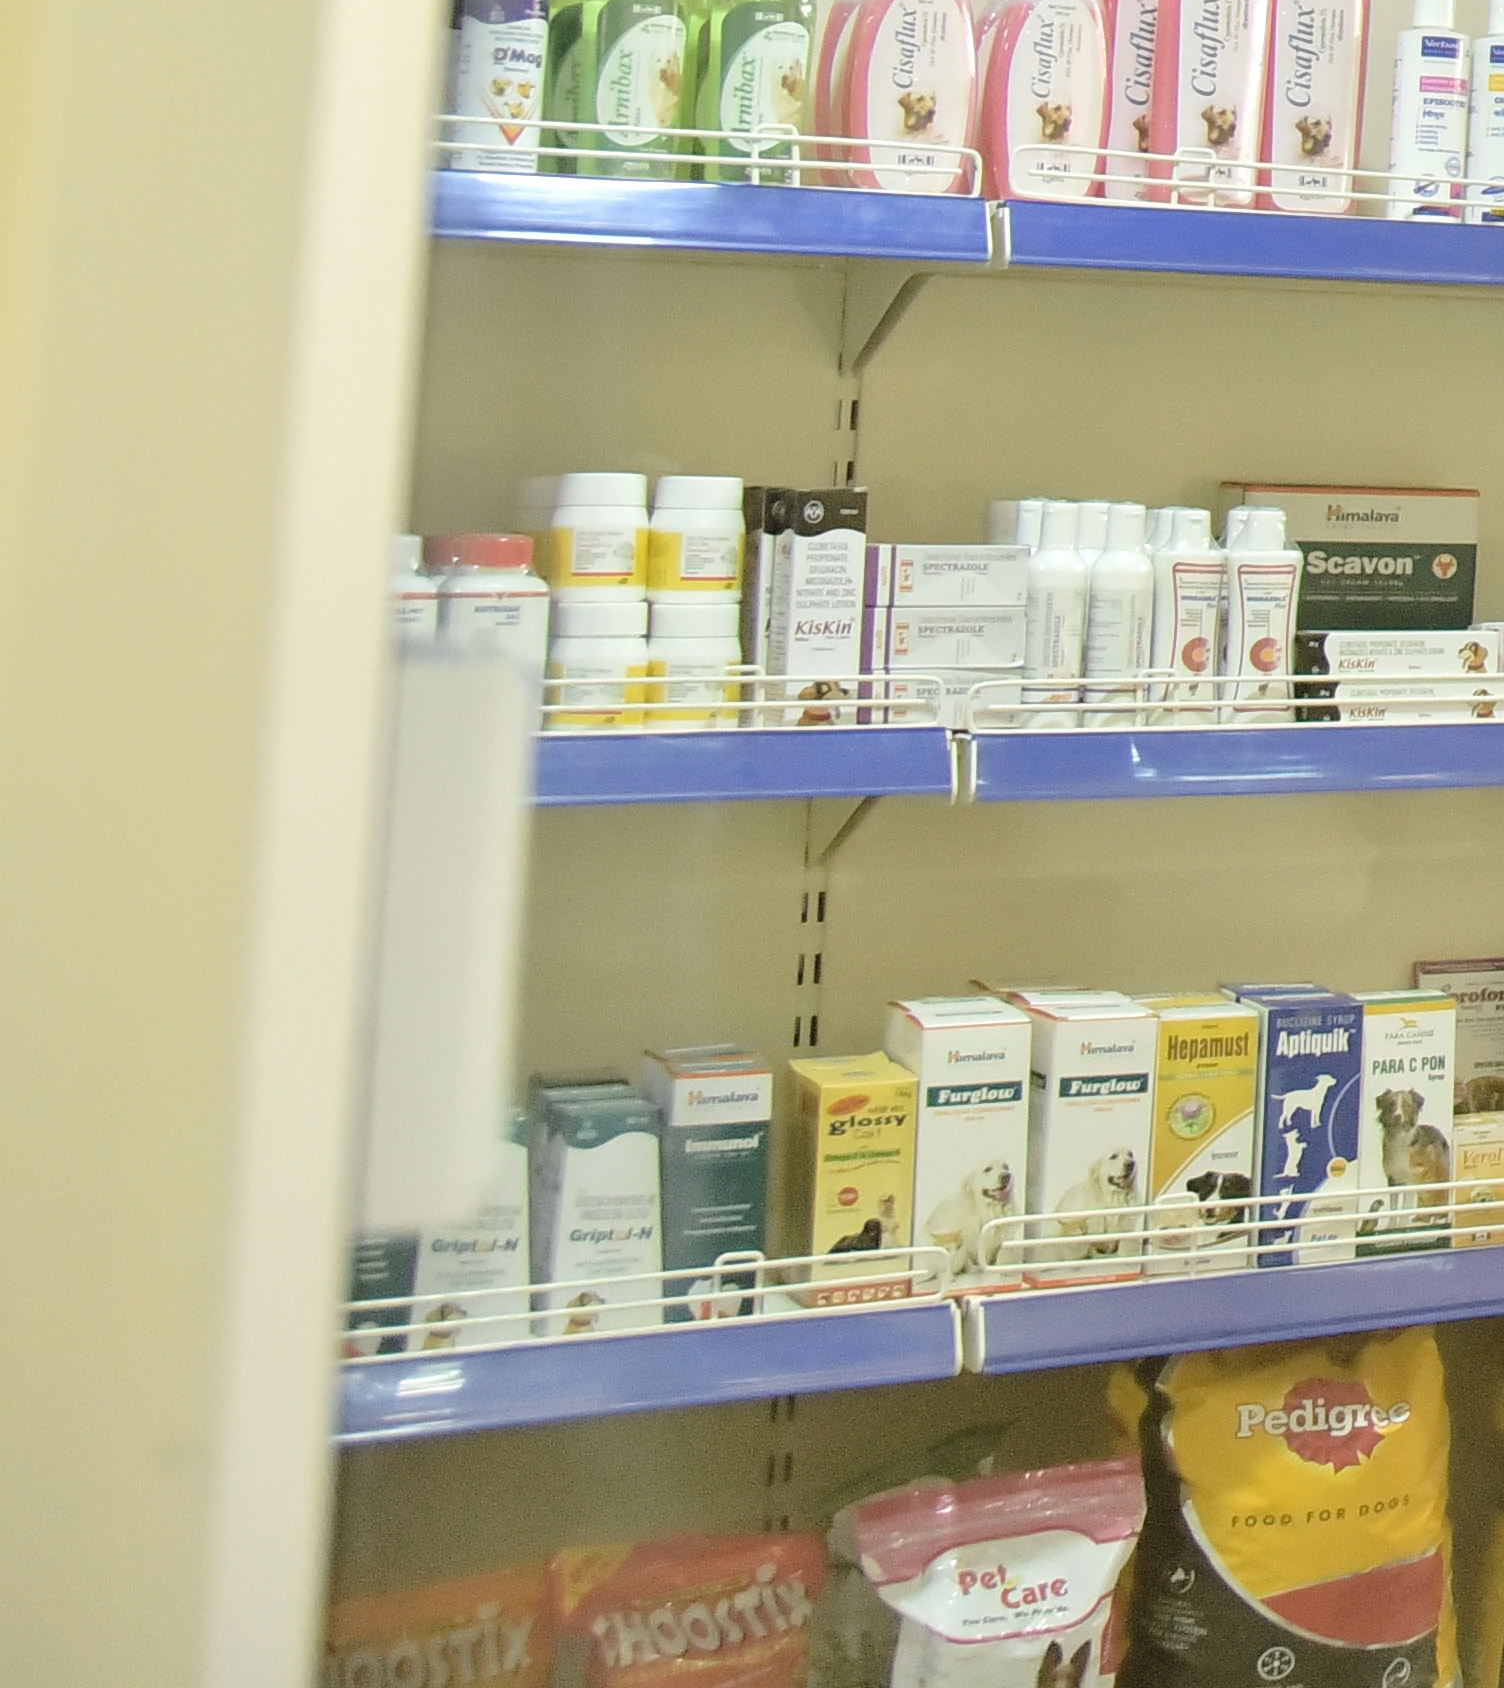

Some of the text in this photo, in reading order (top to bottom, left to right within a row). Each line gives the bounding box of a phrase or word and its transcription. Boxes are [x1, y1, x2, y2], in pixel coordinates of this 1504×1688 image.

[892, 6, 919, 90] Cisaflux
[1285, 5, 1320, 107] Cisaflux
[1031, 19, 1058, 99] Cisaflux
[1327, 505, 1399, 522] Himalaya
[1306, 551, 1413, 574] Scavon
[795, 620, 851, 635] KisKin
[1338, 659, 1375, 670] KisKin
[1350, 708, 1385, 718] KisKin
[1277, 1014, 1355, 1028] BUCLIZINE SYRUP
[1081, 1041, 1135, 1056] Himalaya
[1168, 1031, 1249, 1061] Hepamust
[1276, 1029, 1349, 1058] Aptiquik
[948, 1050, 1006, 1063] Himalaya
[1372, 1055, 1446, 1075] PARA C PON
[937, 1088, 1016, 1106] Furglow
[1069, 1079, 1143, 1096] Furglow
[688, 1090, 758, 1106] Himalaya
[828, 1113, 907, 1136] glossy
[1236, 1398, 1410, 1438] Pedigree
[1232, 1508, 1345, 1527] FOOD FOR
[958, 1565, 1006, 1594] Pet
[999, 1572, 1068, 1609] Care
